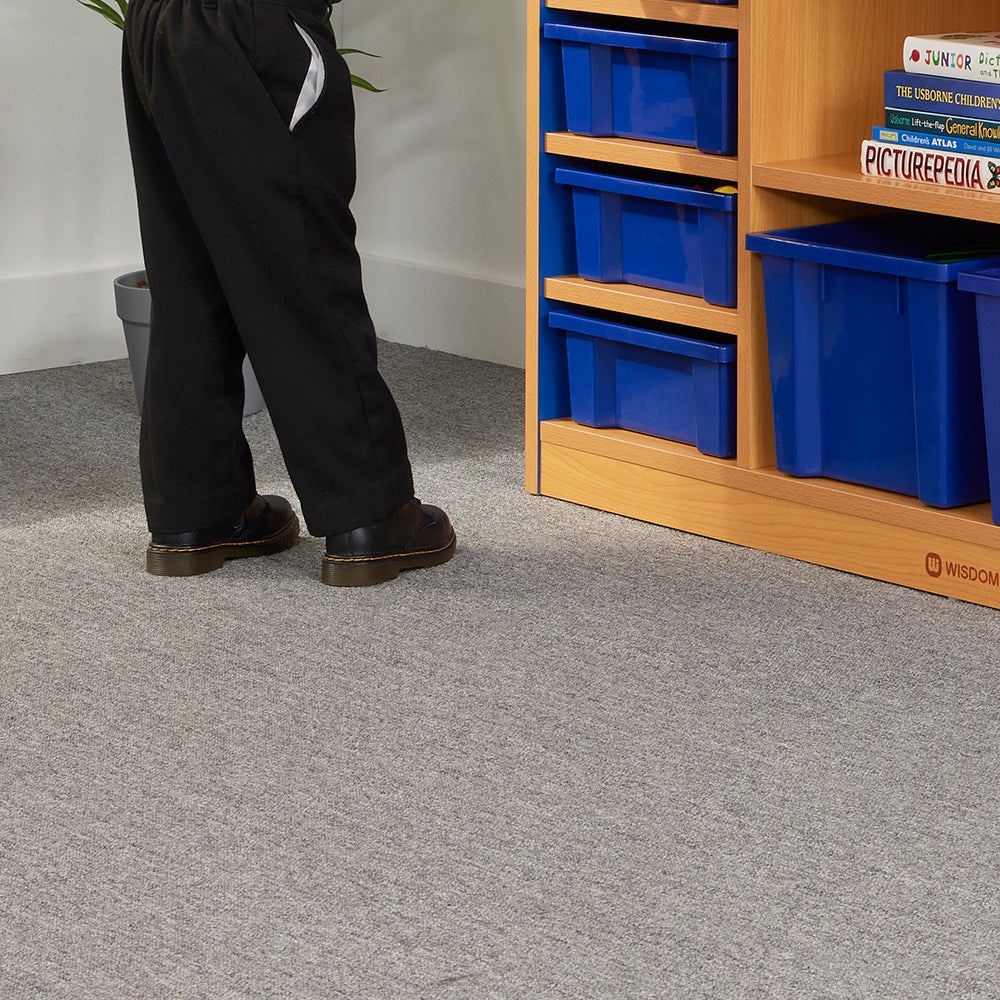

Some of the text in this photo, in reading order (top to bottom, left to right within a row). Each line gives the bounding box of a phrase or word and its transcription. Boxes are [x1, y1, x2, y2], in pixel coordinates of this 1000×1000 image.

[924, 50, 972, 70] JUNIOR
[979, 69, 992, 77] and
[896, 85, 913, 98] THE
[914, 87, 953, 104] USBORNE
[911, 117, 945, 133] Lift-the-flap
[945, 117, 977, 137] General
[901, 134, 930, 145] Children's
[931, 137, 957, 149] ATLAS
[865, 145, 985, 190] PICTUREPEDIA
[945, 560, 999, 588] WISDOM
